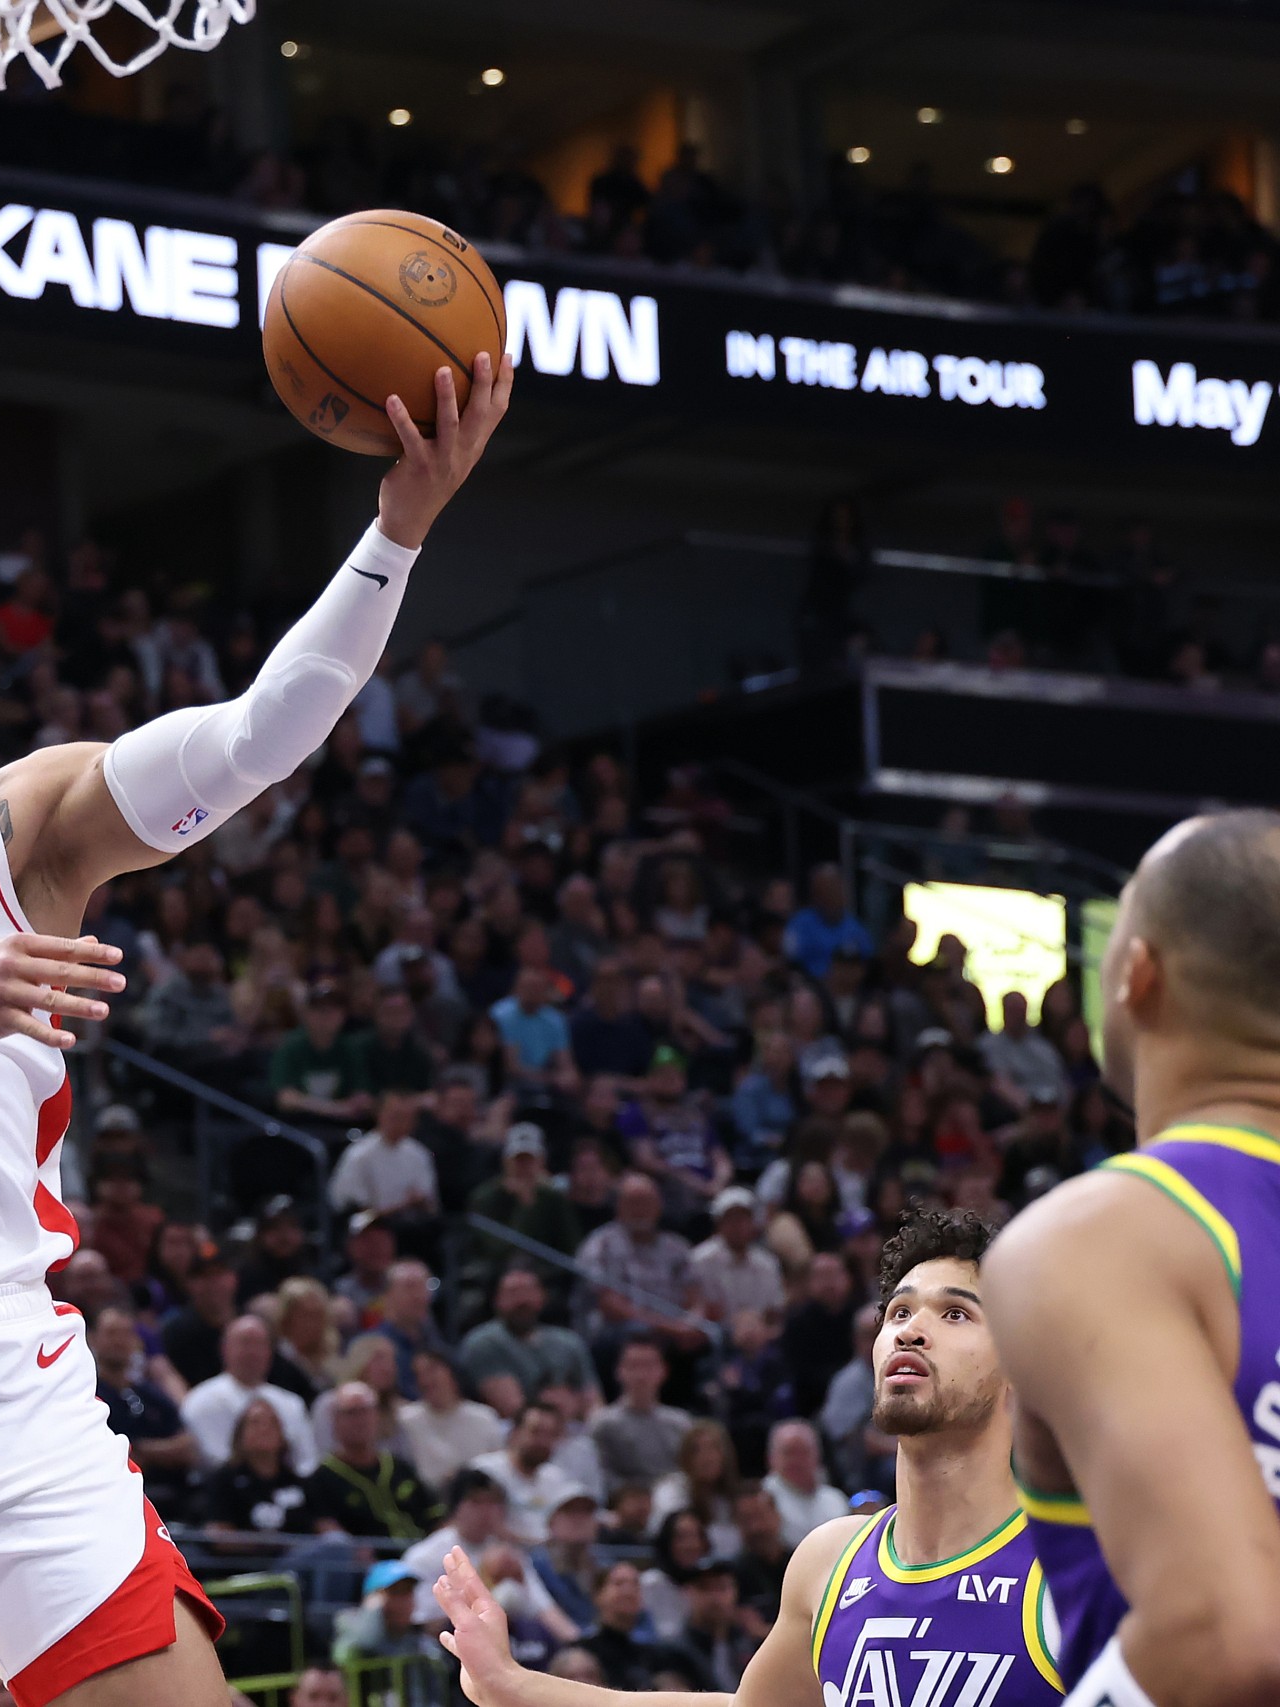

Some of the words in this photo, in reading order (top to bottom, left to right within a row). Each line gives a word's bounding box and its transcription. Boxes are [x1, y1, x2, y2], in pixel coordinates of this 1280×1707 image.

[726, 331, 776, 381] IN
[779, 336, 858, 390] THE
[861, 347, 931, 398] AIR
[933, 354, 1047, 409] TOUR
[1132, 360, 1272, 447] May
[957, 1575, 1019, 1604] LVT
